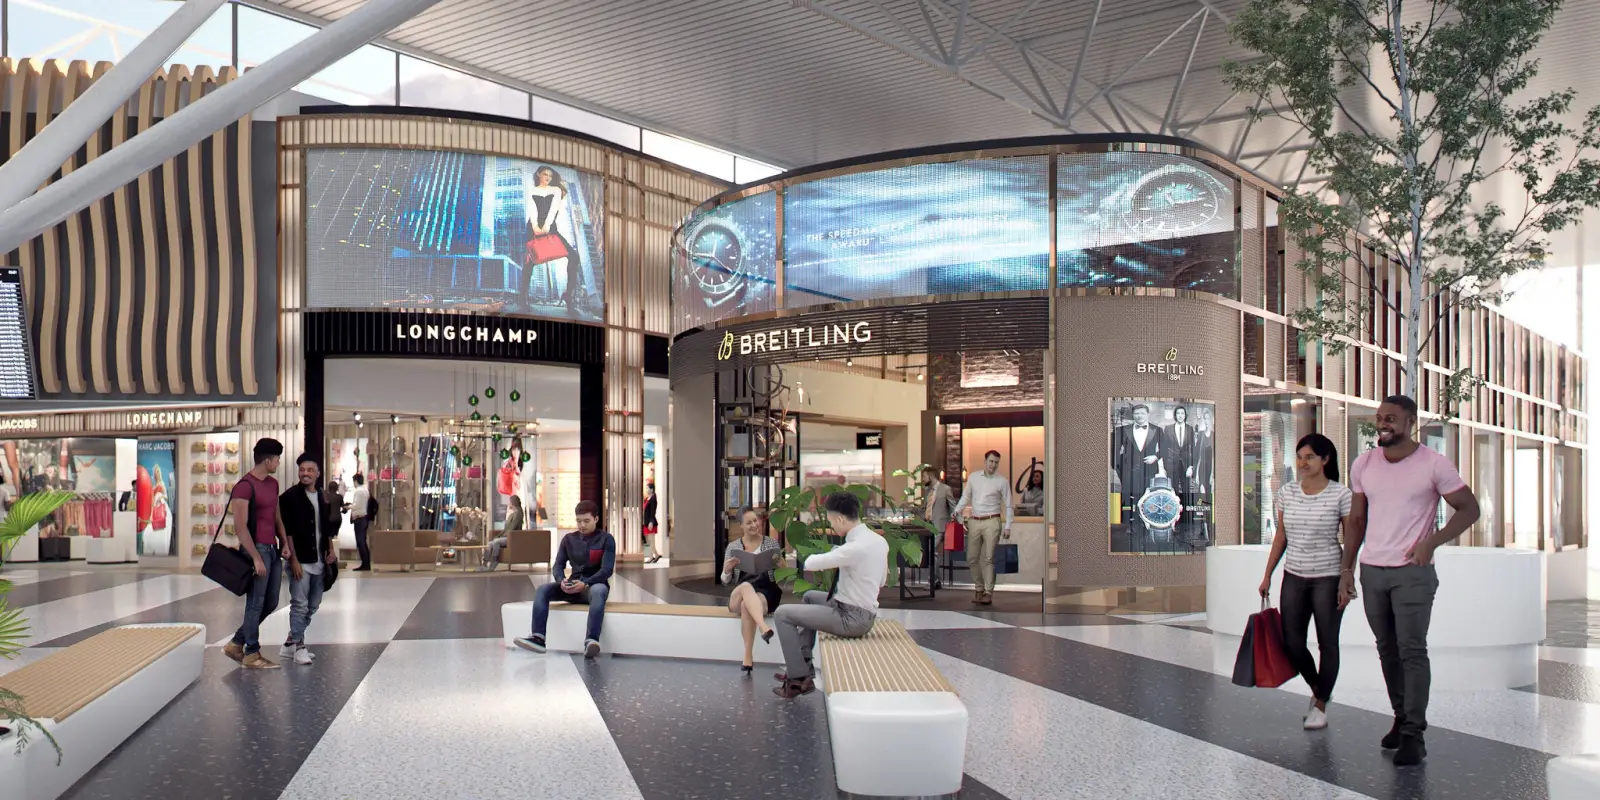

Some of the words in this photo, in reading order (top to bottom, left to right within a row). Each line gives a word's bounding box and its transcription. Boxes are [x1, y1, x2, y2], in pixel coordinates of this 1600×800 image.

[396, 324, 538, 344] LONGCHAMP
[740, 321, 872, 355] BREITLING
[1137, 363, 1204, 375] BREITLING
[126, 411, 202, 425] LONGCHAMP
